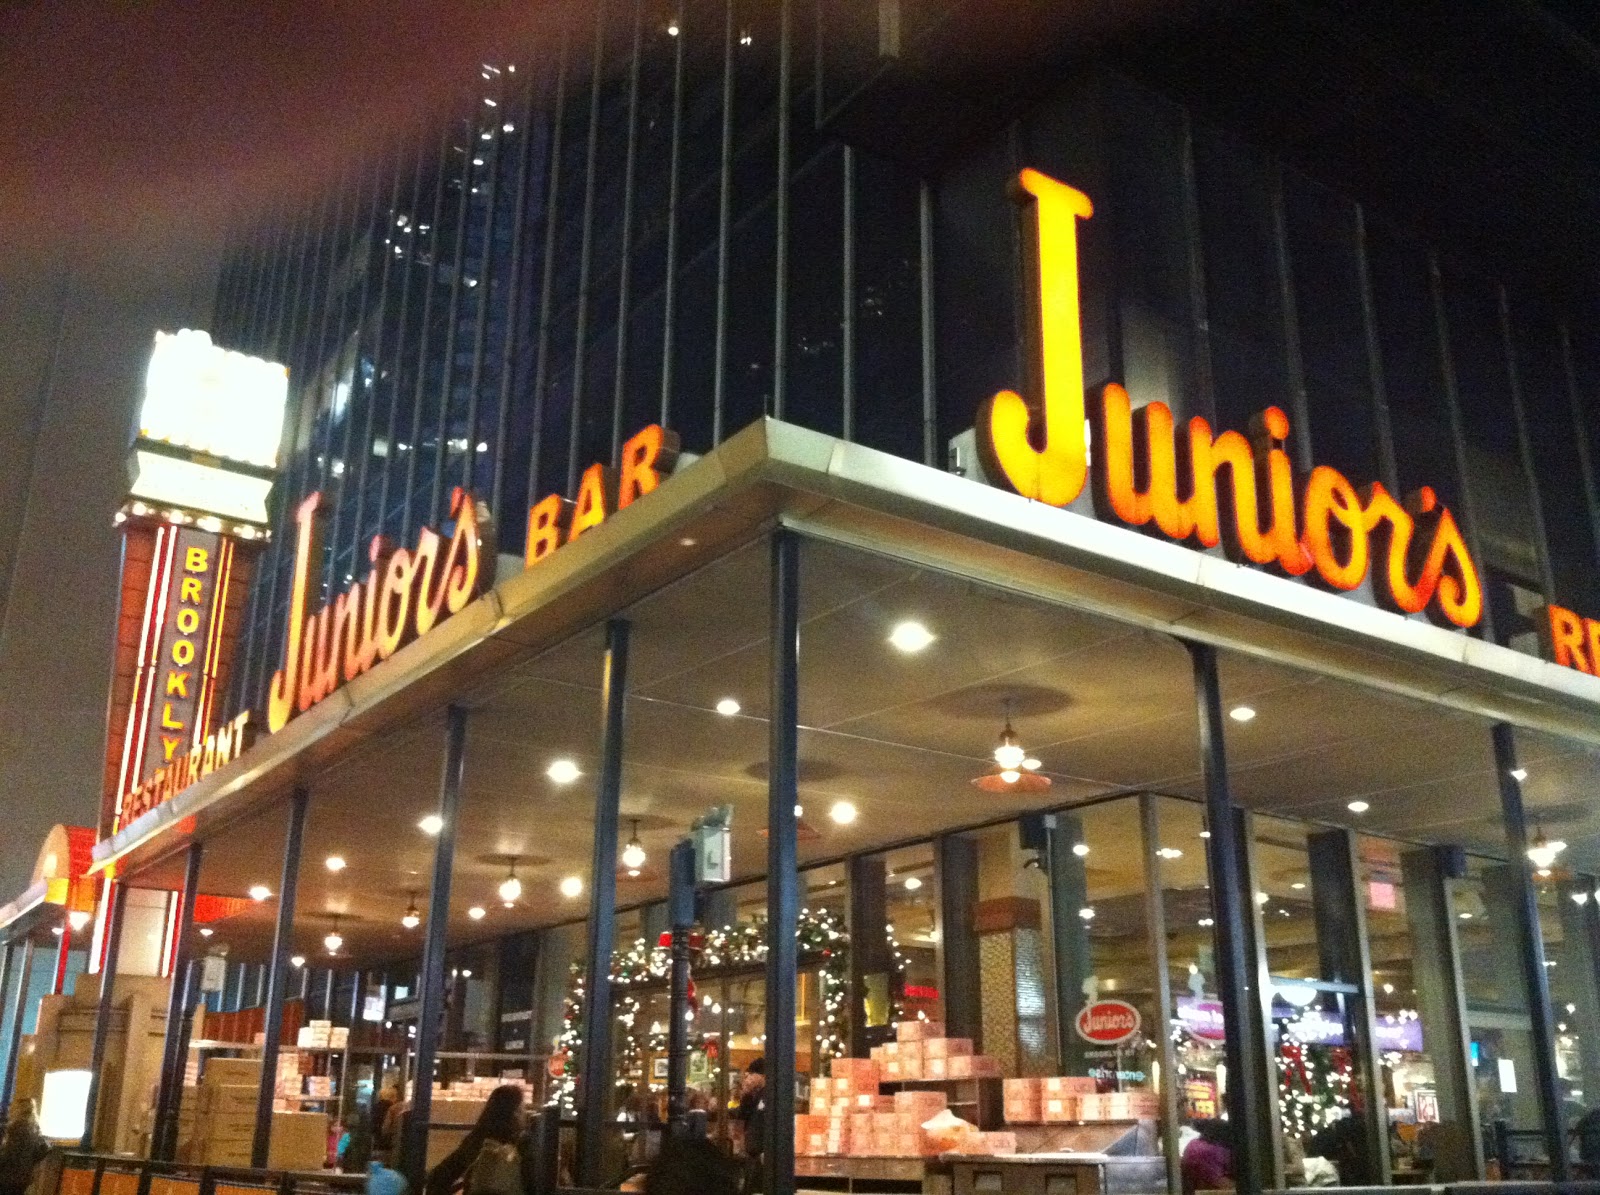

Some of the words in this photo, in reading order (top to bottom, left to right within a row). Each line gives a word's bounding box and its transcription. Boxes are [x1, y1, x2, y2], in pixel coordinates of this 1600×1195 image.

[991, 167, 1483, 628] Junior's
[118, 709, 249, 831] RESTAURANT
[269, 486, 480, 734] Junior's
[526, 424, 664, 569] BAR
[156, 546, 208, 776] BROOKLY
